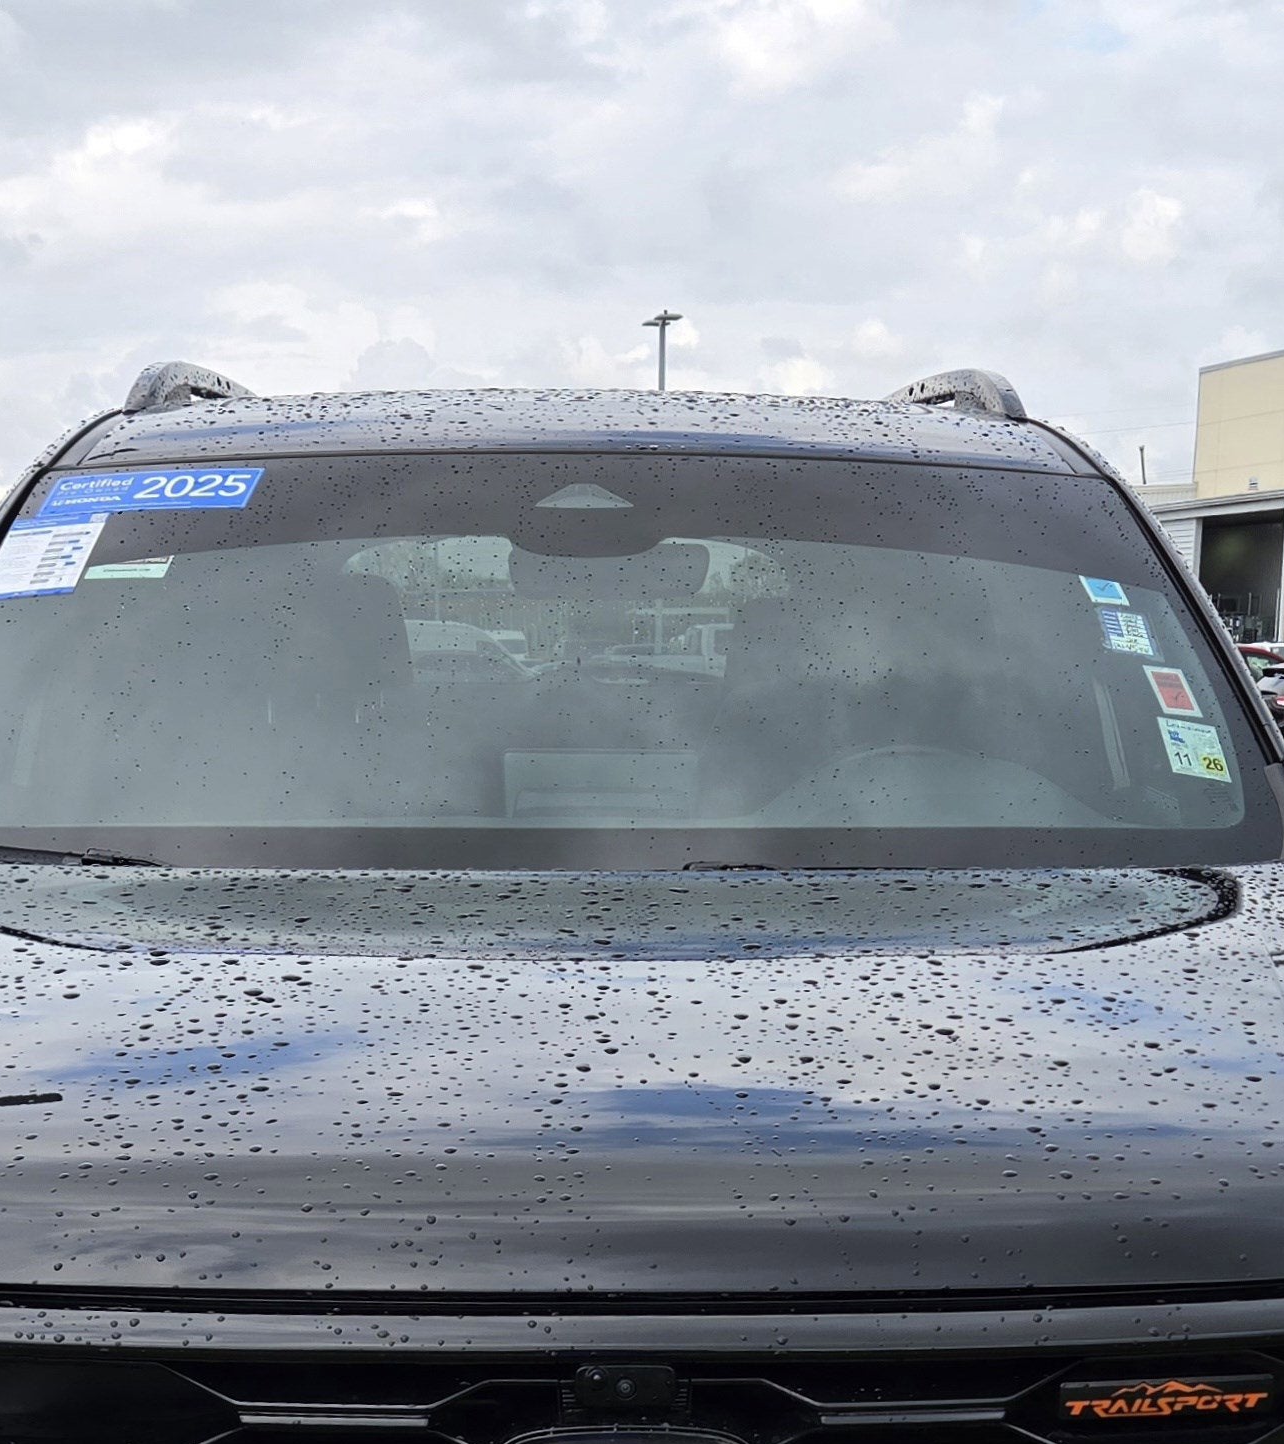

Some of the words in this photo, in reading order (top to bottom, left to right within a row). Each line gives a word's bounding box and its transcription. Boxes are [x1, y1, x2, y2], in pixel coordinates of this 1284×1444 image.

[60, 477, 135, 491] Certified
[133, 474, 252, 500] 2025
[64, 495, 122, 506] HONDA
[1174, 751, 1192, 767] 11
[1203, 756, 1224, 772] 26
[1065, 1392, 1268, 1418] TRAILSPORT
